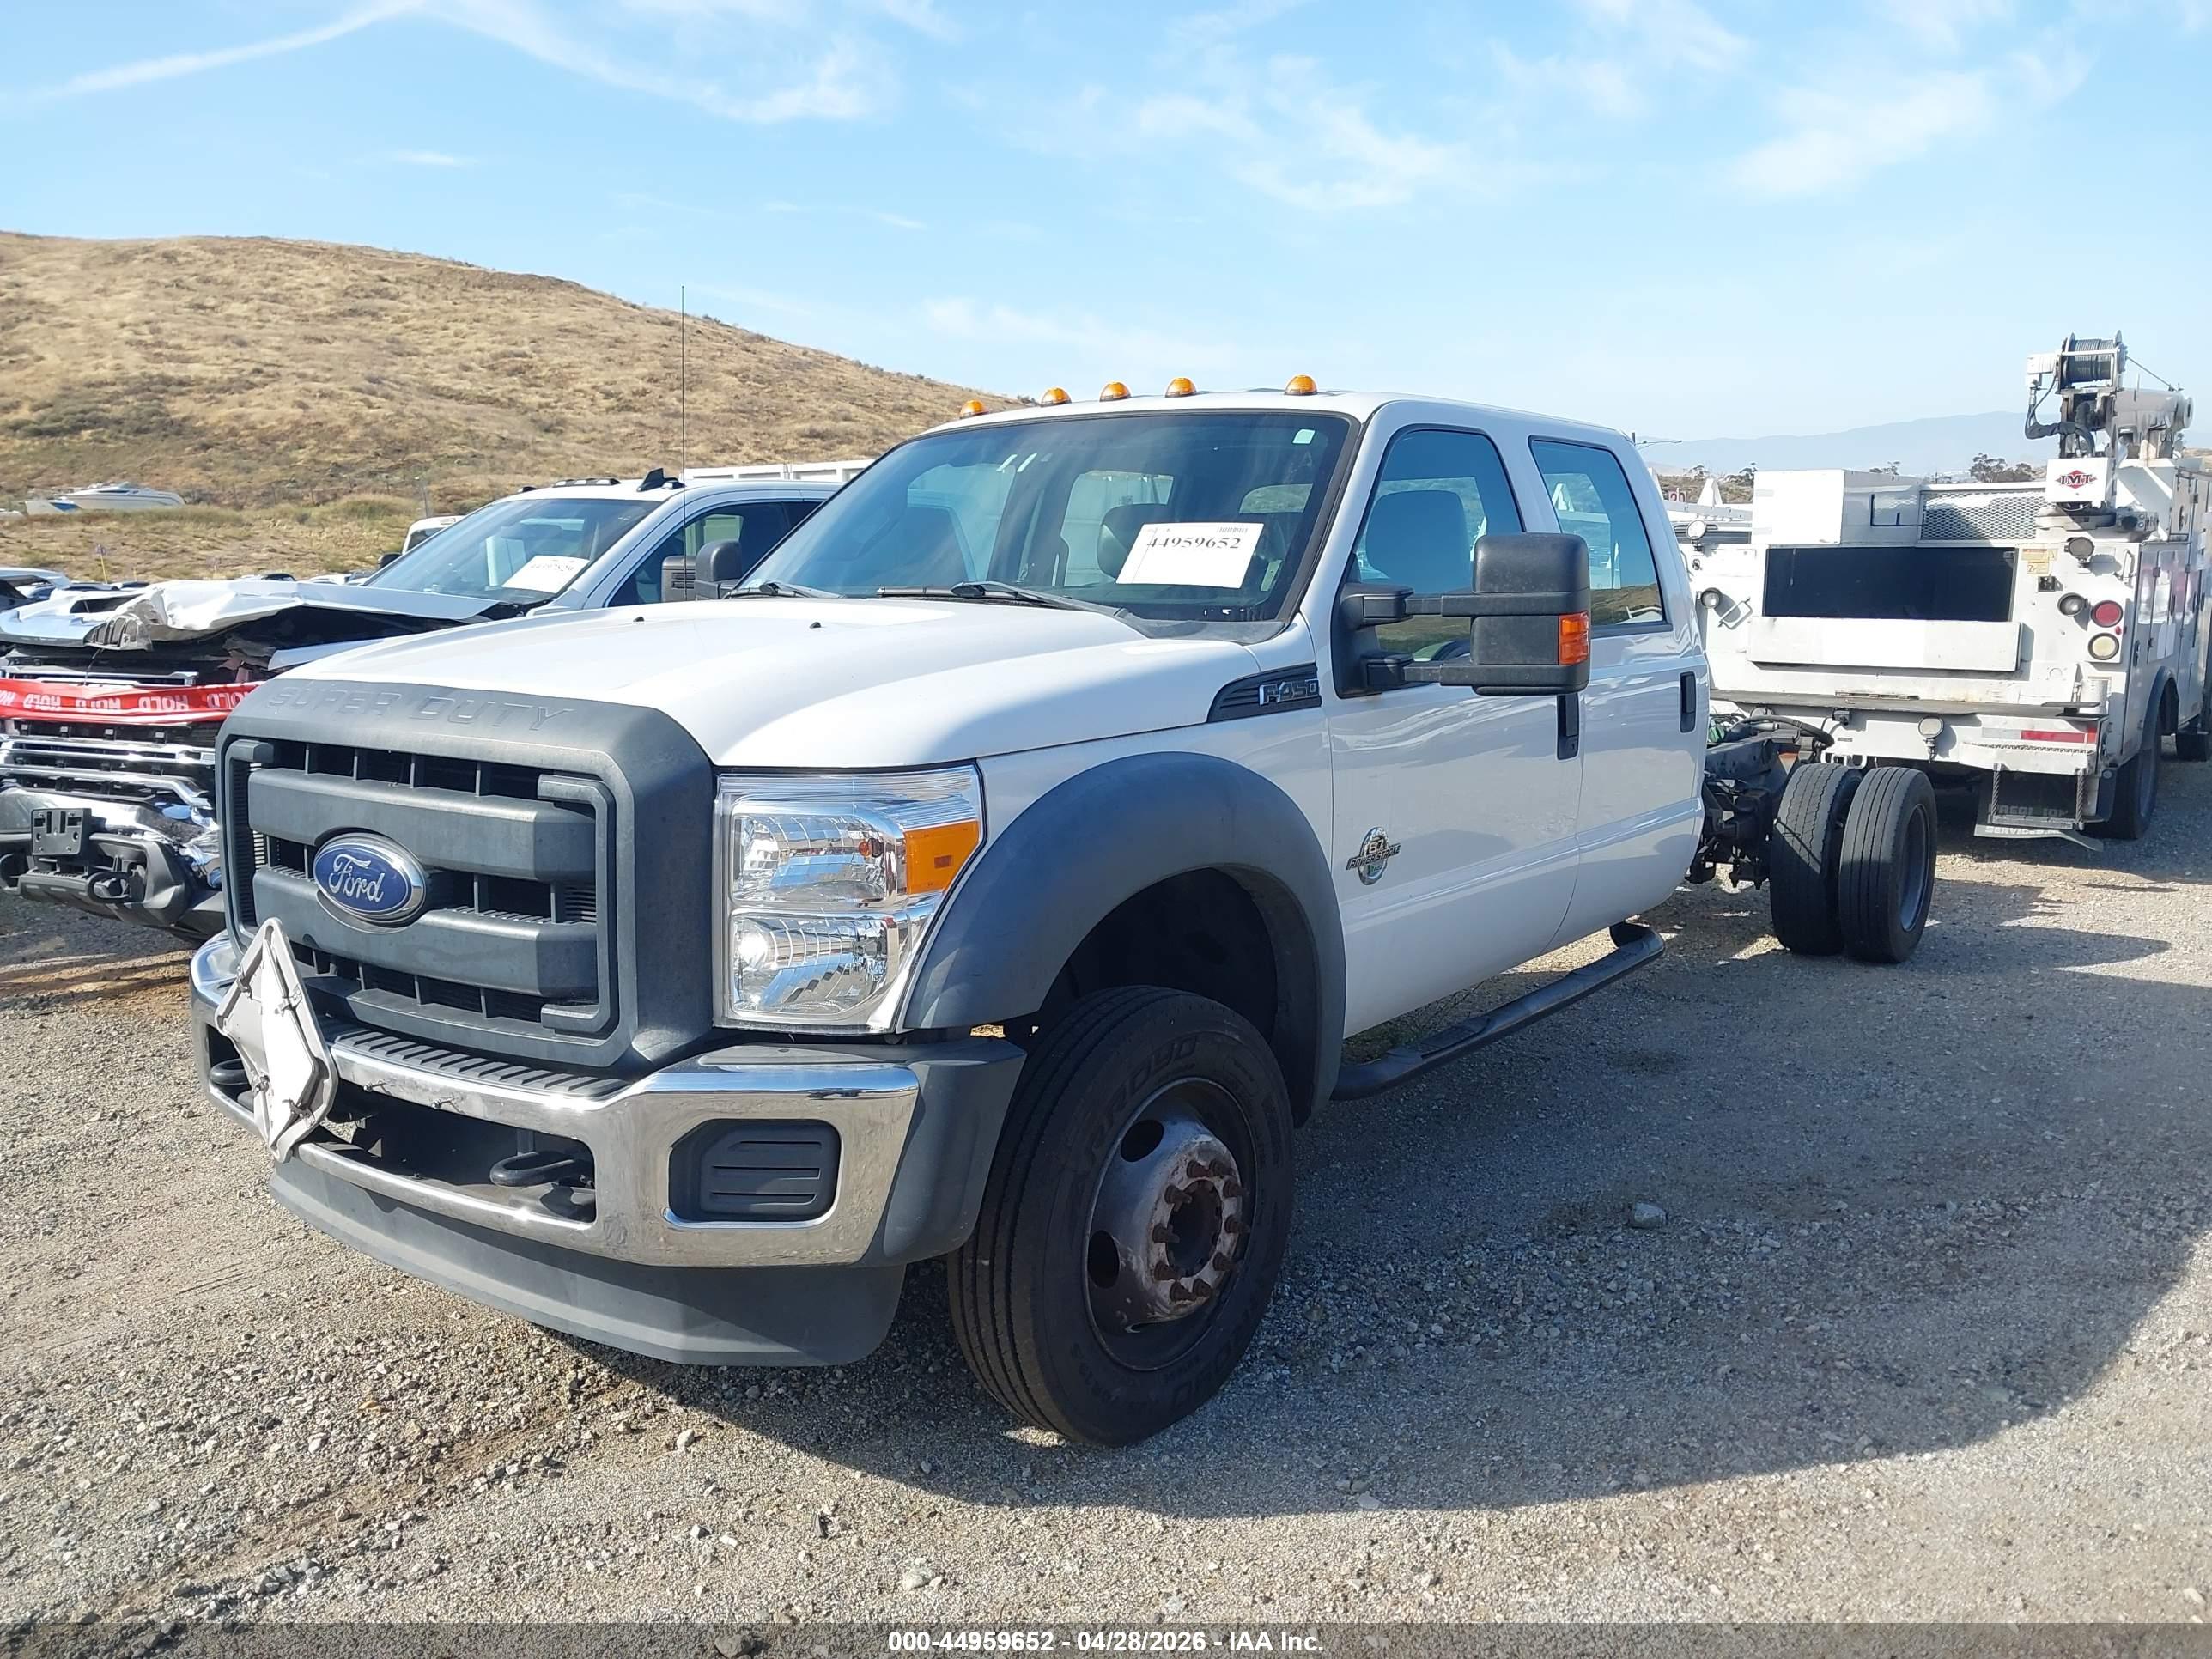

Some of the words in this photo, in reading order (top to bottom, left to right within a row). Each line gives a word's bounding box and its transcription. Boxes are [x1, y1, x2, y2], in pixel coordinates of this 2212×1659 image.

[2061, 474, 2093, 485] IMT
[1146, 537, 1242, 549] 44959652
[138, 694, 190, 713] HOLD
[206, 691, 251, 708] OLD
[267, 686, 403, 716] SUPER
[409, 695, 575, 731] DUTY
[328, 854, 386, 902] Ford
